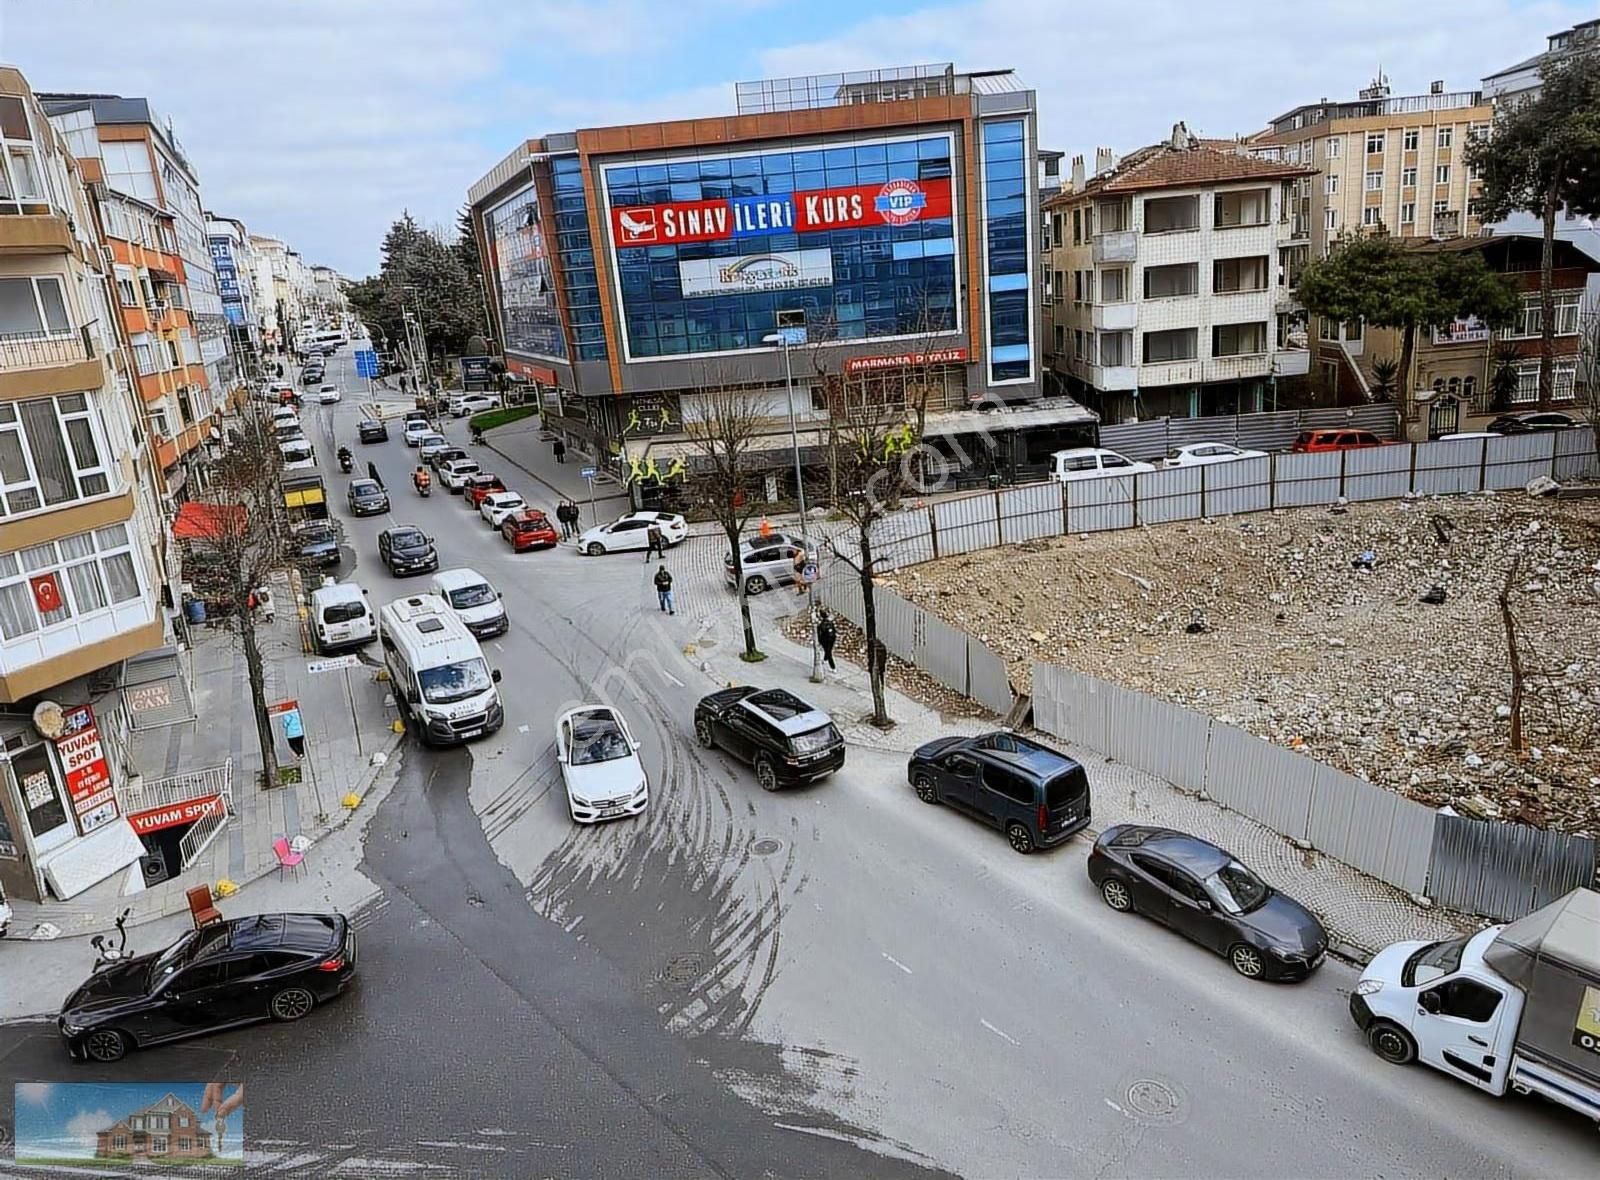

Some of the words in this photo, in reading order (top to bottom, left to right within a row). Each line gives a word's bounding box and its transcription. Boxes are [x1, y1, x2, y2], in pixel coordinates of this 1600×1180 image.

[805, 193, 863, 226] KURS
[889, 195, 913, 208] VIP
[58, 731, 100, 757] YUVAM
[68, 746, 97, 768] SPOT
[136, 809, 182, 829] YUVAM
[185, 800, 218, 817] SPOT
